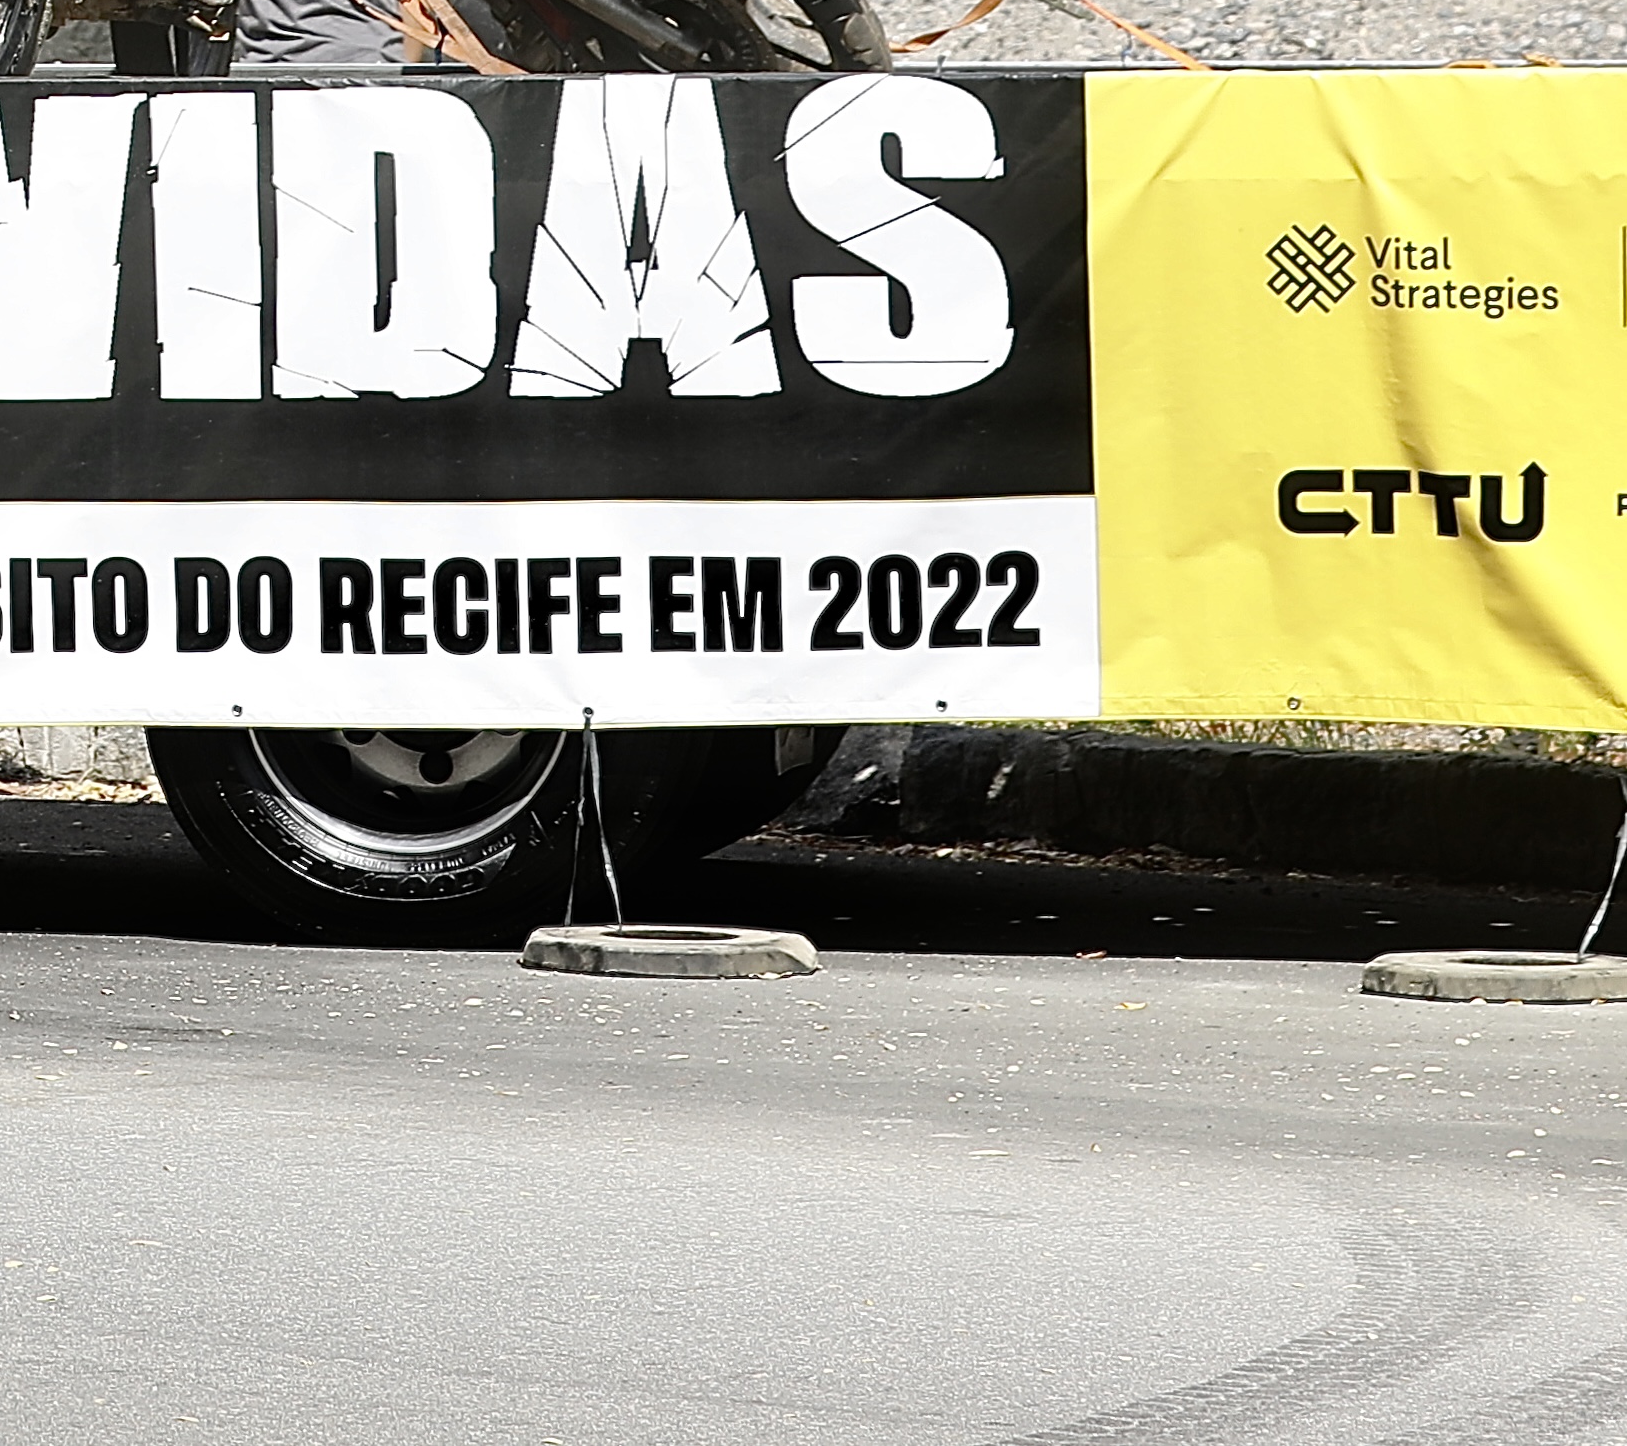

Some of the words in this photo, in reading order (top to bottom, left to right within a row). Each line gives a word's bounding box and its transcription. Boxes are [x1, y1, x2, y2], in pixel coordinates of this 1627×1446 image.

[1365, 235, 1452, 271] Vital
[1370, 274, 1560, 320] Strategies
[1277, 461, 1549, 543] CTTU
[174, 555, 294, 654] DO
[320, 555, 623, 655] RECIFE
[649, 555, 784, 653] EM
[808, 550, 1041, 652] 2022
